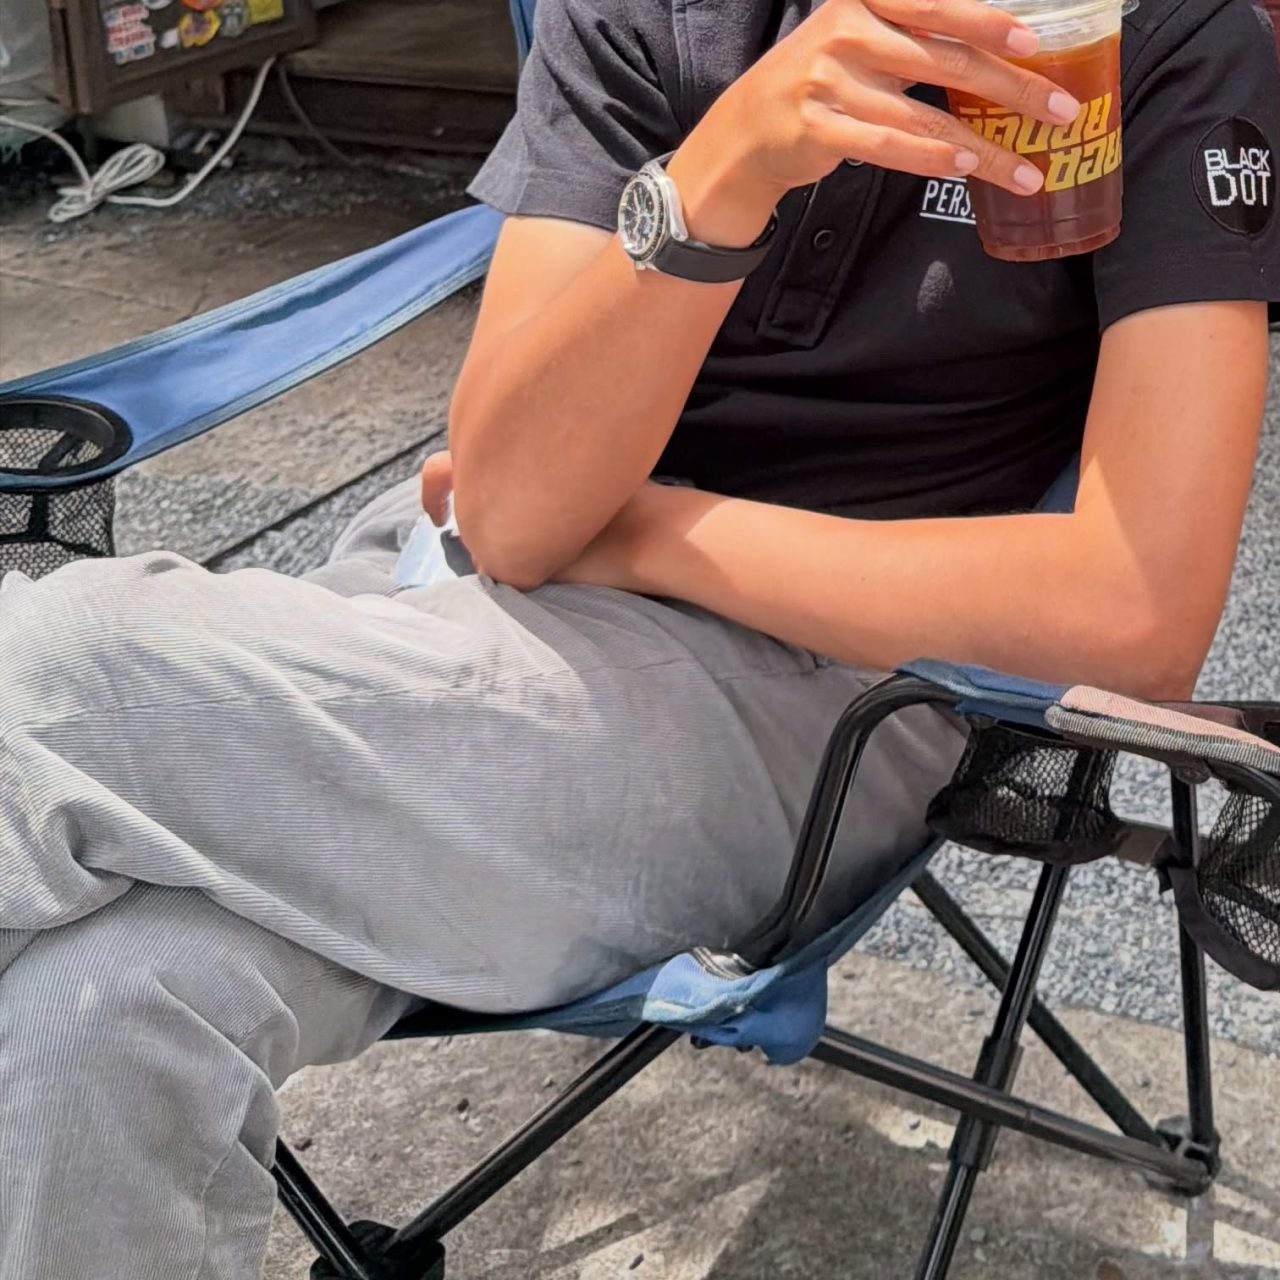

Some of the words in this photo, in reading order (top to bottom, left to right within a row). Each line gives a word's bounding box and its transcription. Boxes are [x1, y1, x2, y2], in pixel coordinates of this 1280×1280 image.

[1204, 147, 1270, 171] BLACK
[922, 179, 976, 219] PERS
[1207, 169, 1271, 208] DOT
